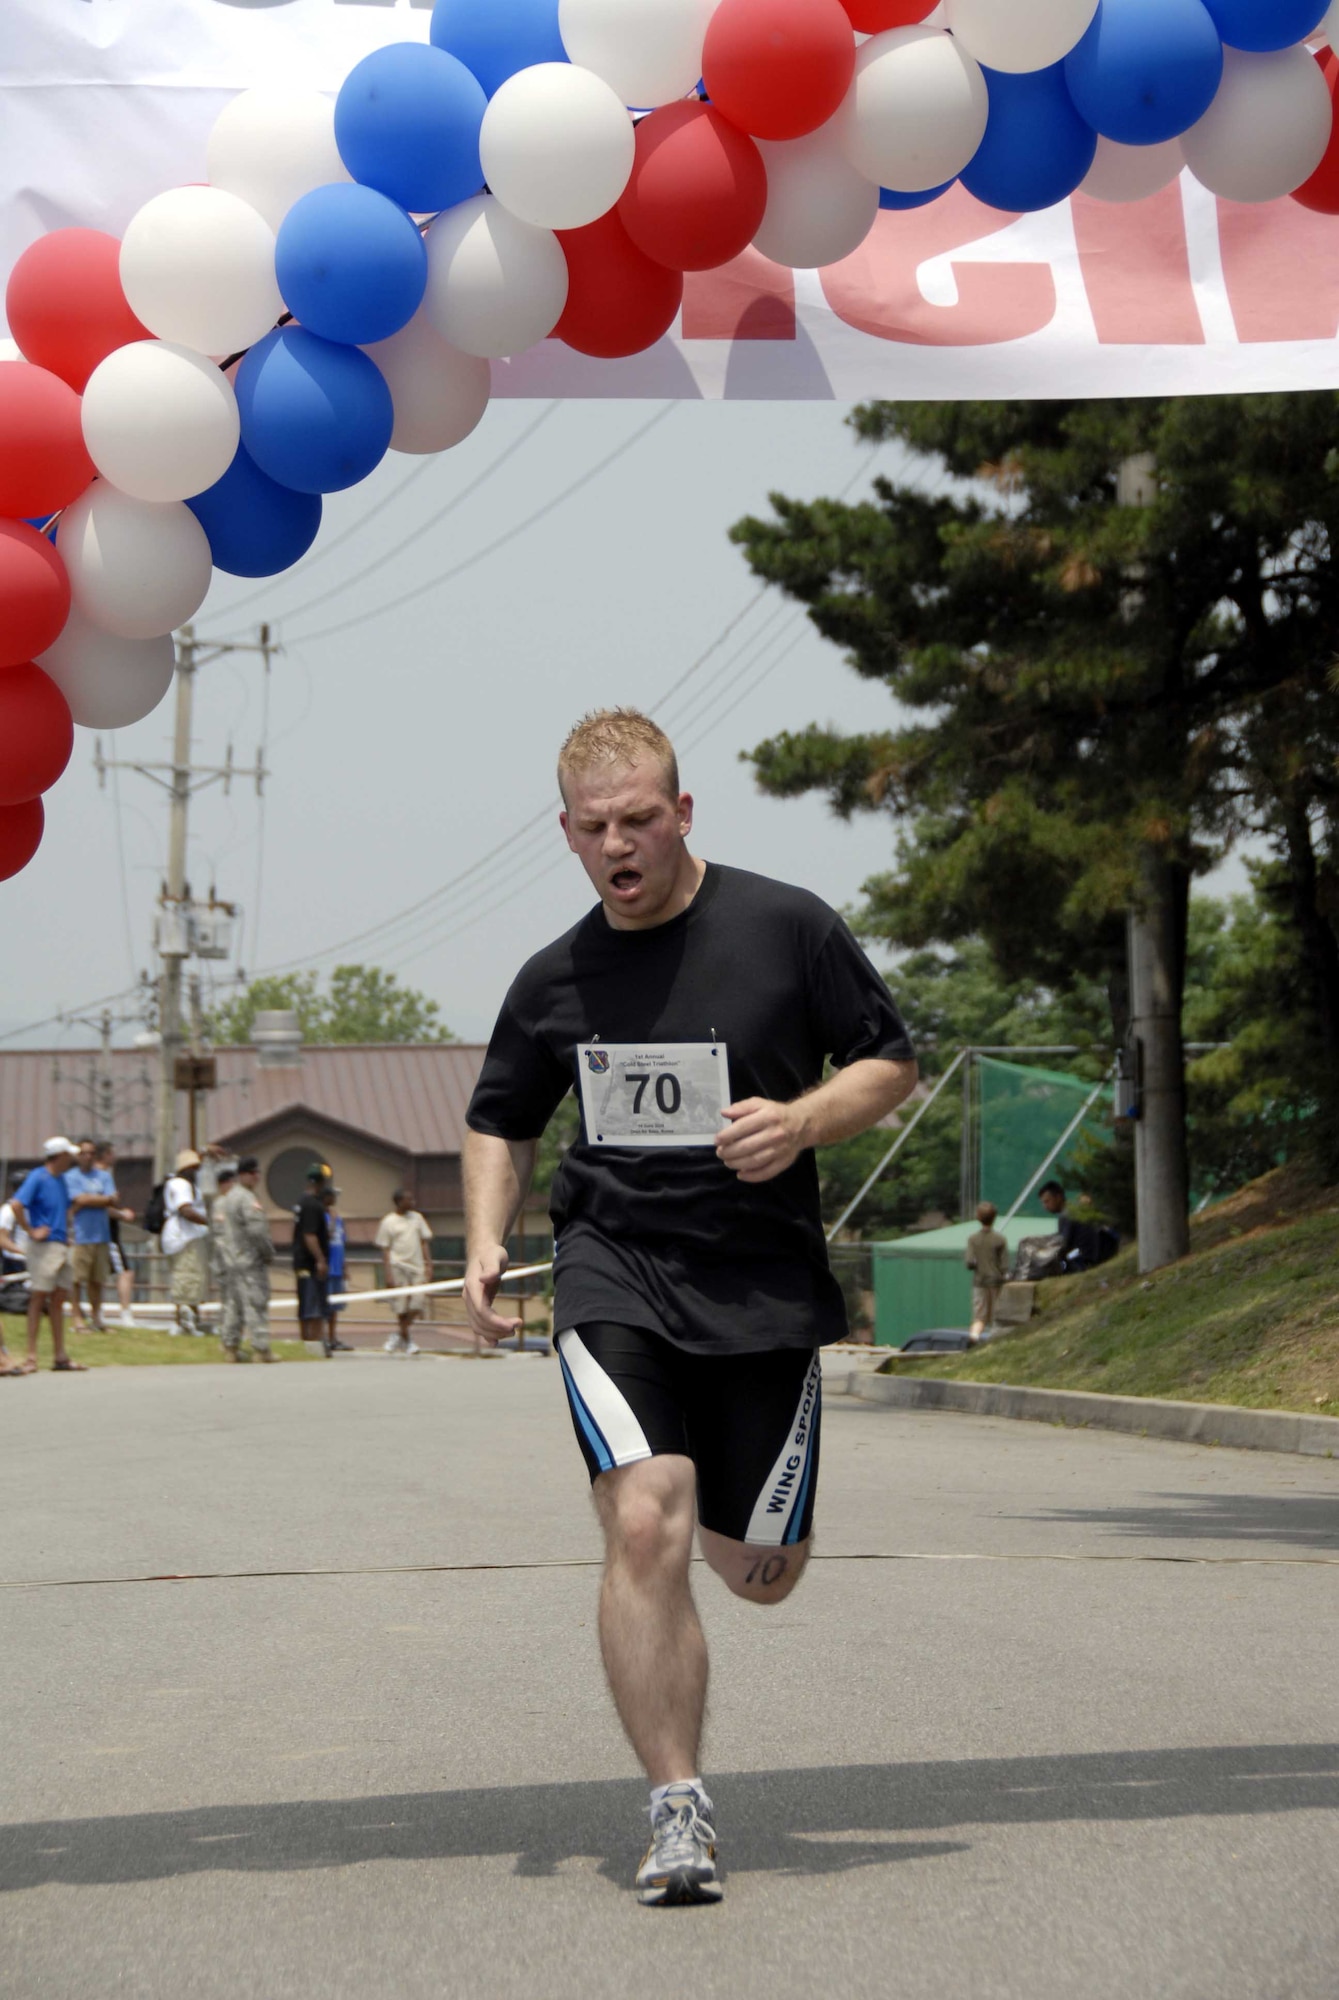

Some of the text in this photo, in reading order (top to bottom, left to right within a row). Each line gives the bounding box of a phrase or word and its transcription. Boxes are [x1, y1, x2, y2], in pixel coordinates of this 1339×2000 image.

[625, 1072, 682, 1114] 70
[766, 1455, 800, 1513] WING
[742, 1553, 788, 1585] 70
